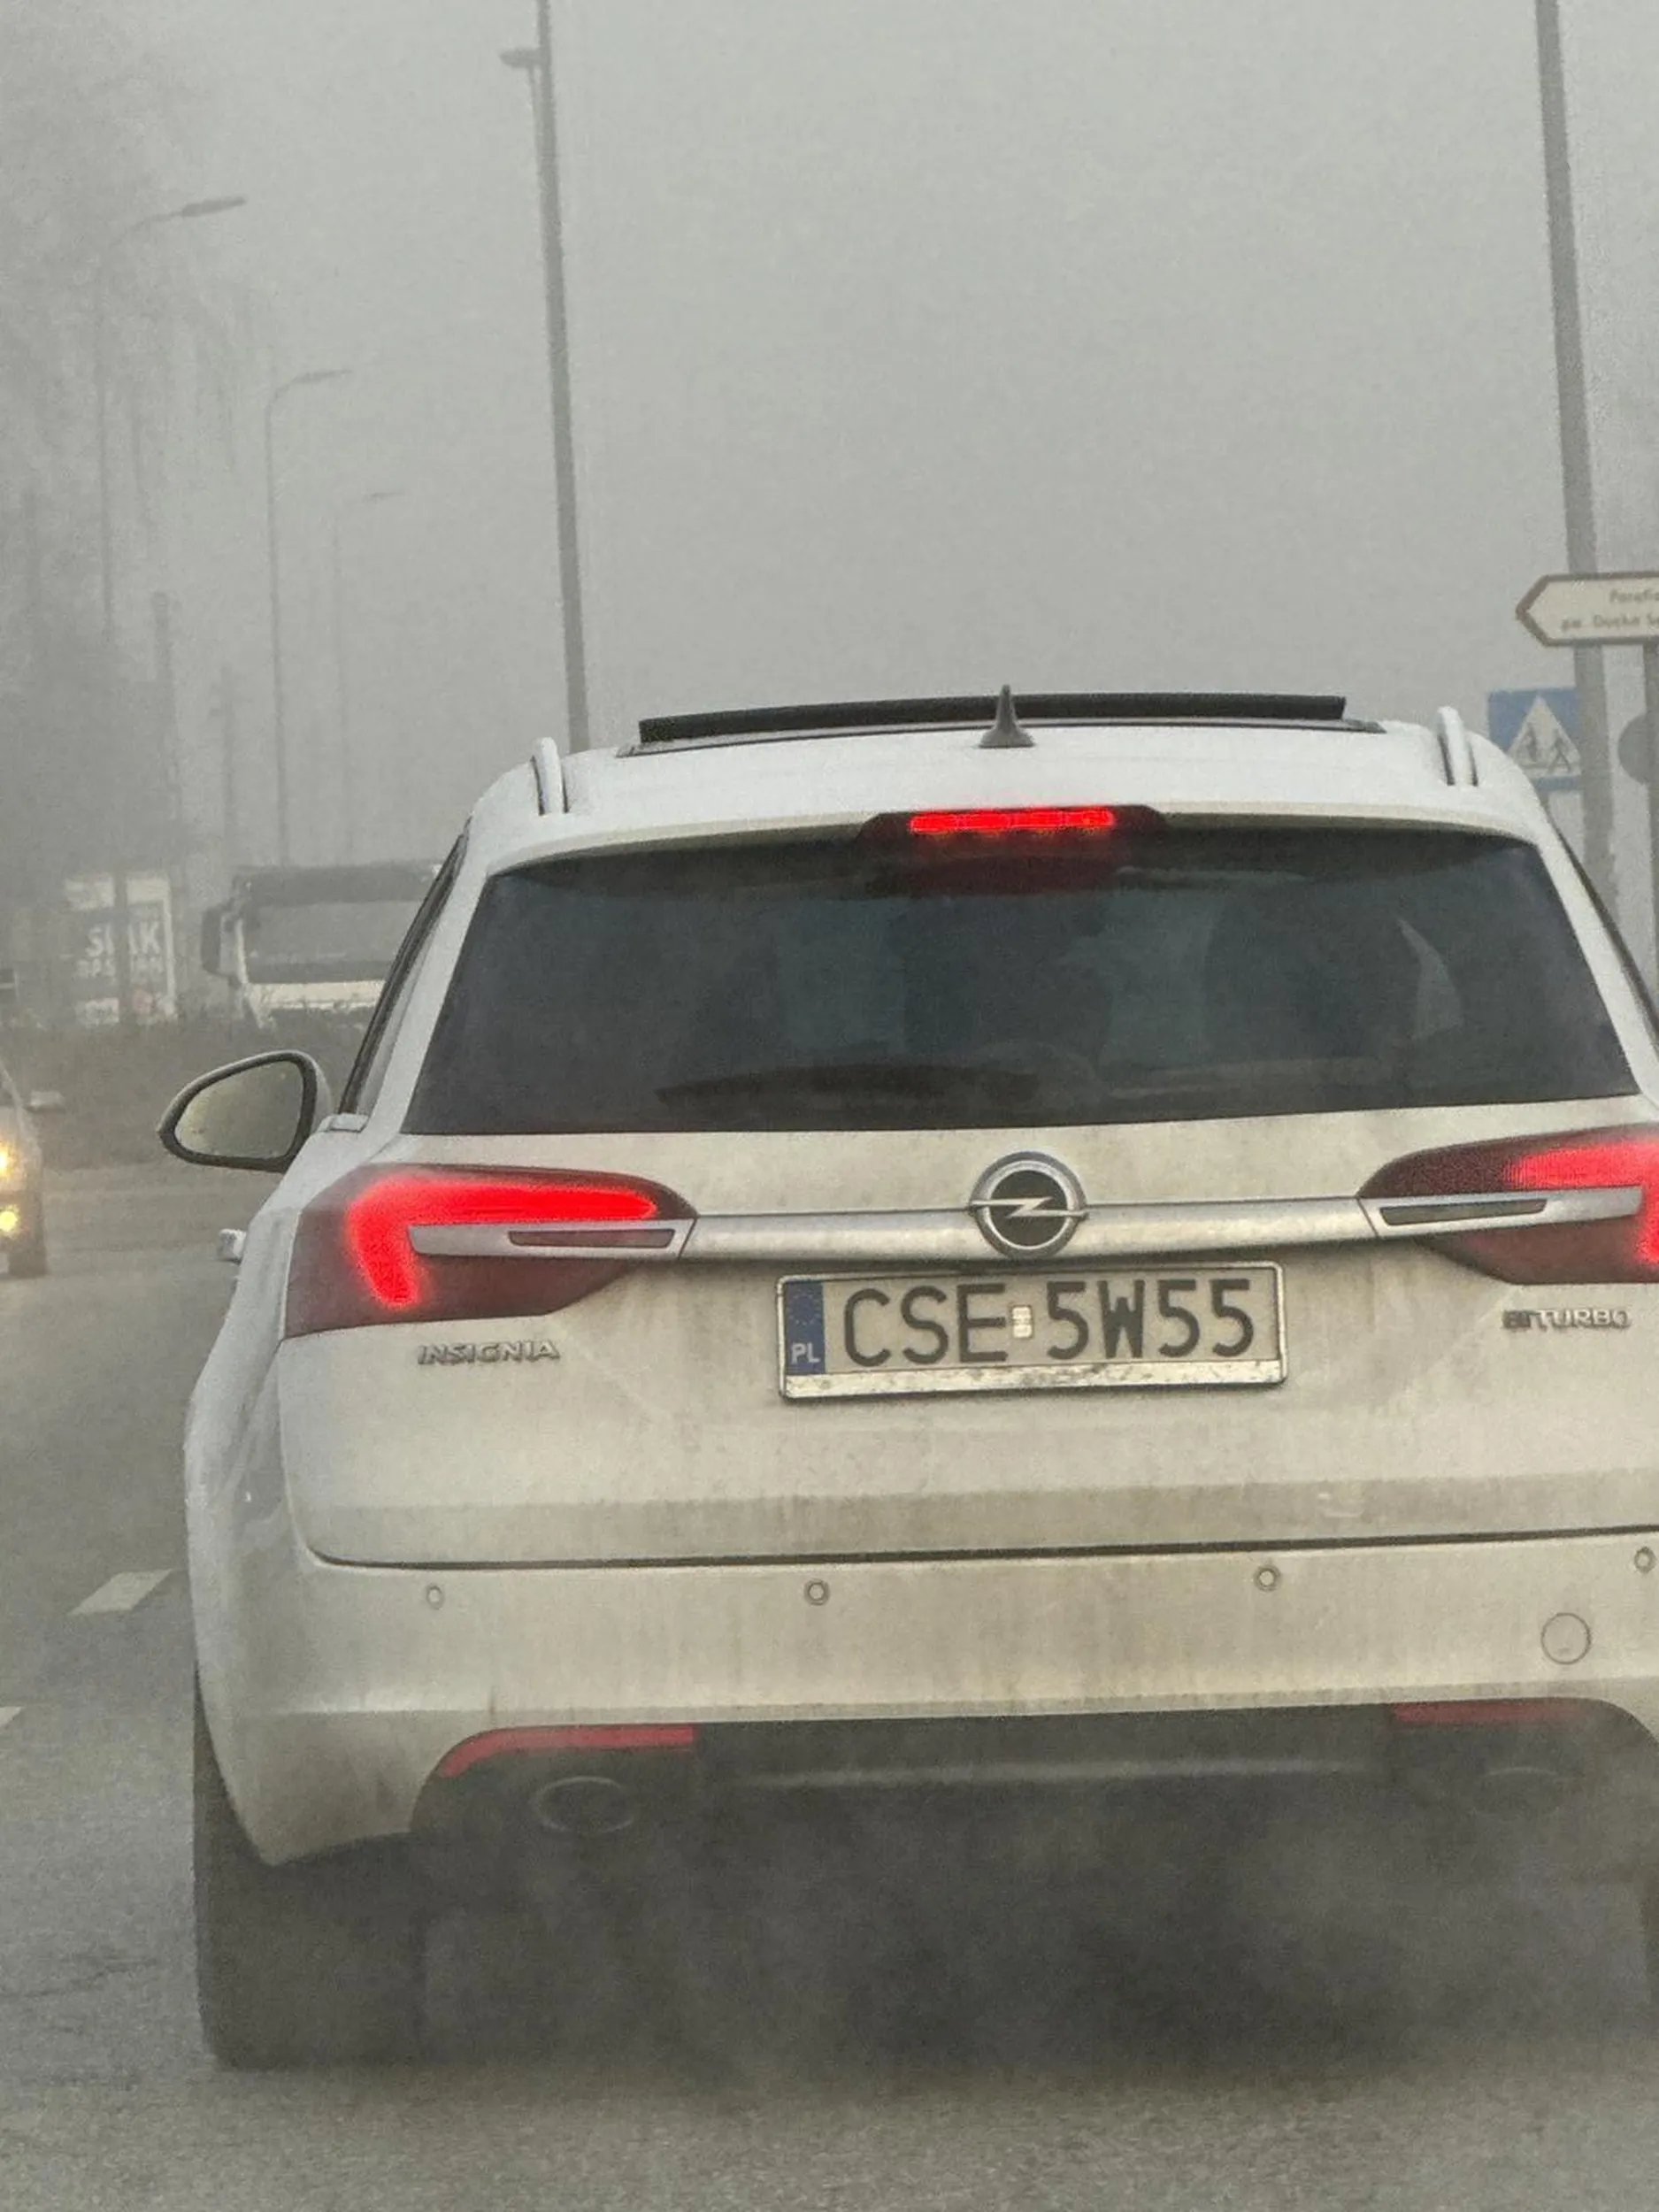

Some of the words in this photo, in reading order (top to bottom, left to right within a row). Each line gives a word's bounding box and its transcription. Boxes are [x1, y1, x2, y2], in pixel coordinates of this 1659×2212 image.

[844, 1283, 1009, 1367] CSE
[1047, 1278, 1254, 1360] 5W55
[417, 1339, 561, 1366] INSIGNIA
[791, 1341, 821, 1364] PL
